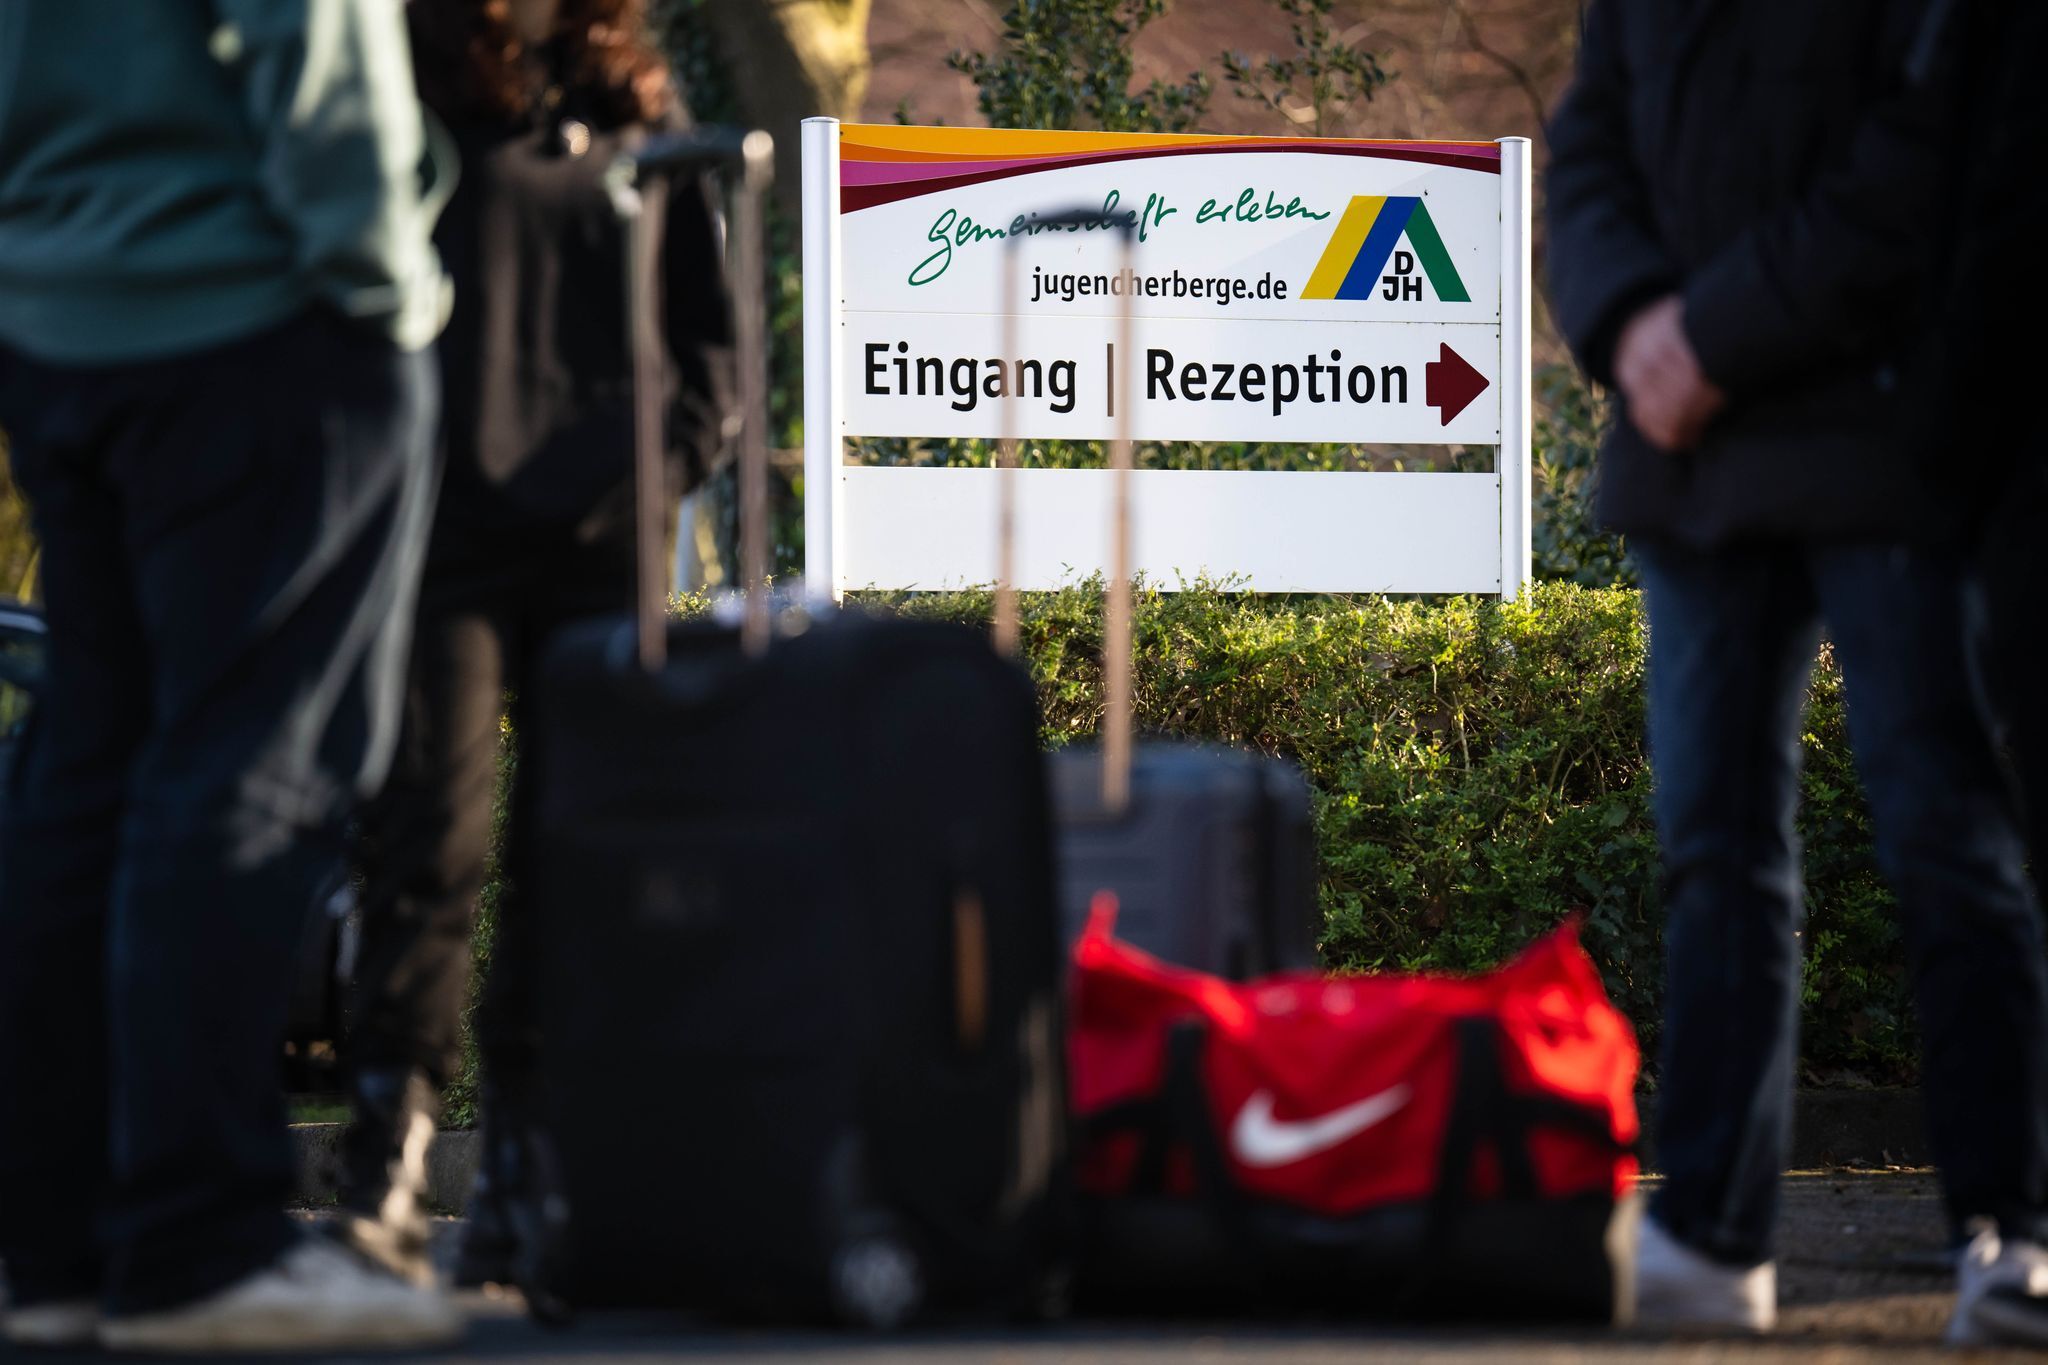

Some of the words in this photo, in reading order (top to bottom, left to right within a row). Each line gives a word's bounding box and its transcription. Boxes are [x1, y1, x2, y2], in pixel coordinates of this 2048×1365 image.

[1195, 187, 1331, 224] erleben
[1031, 265, 1288, 305] jugendherberge.de
[864, 341, 1077, 412] Eingang
[1146, 348, 1408, 417] Rezeption
